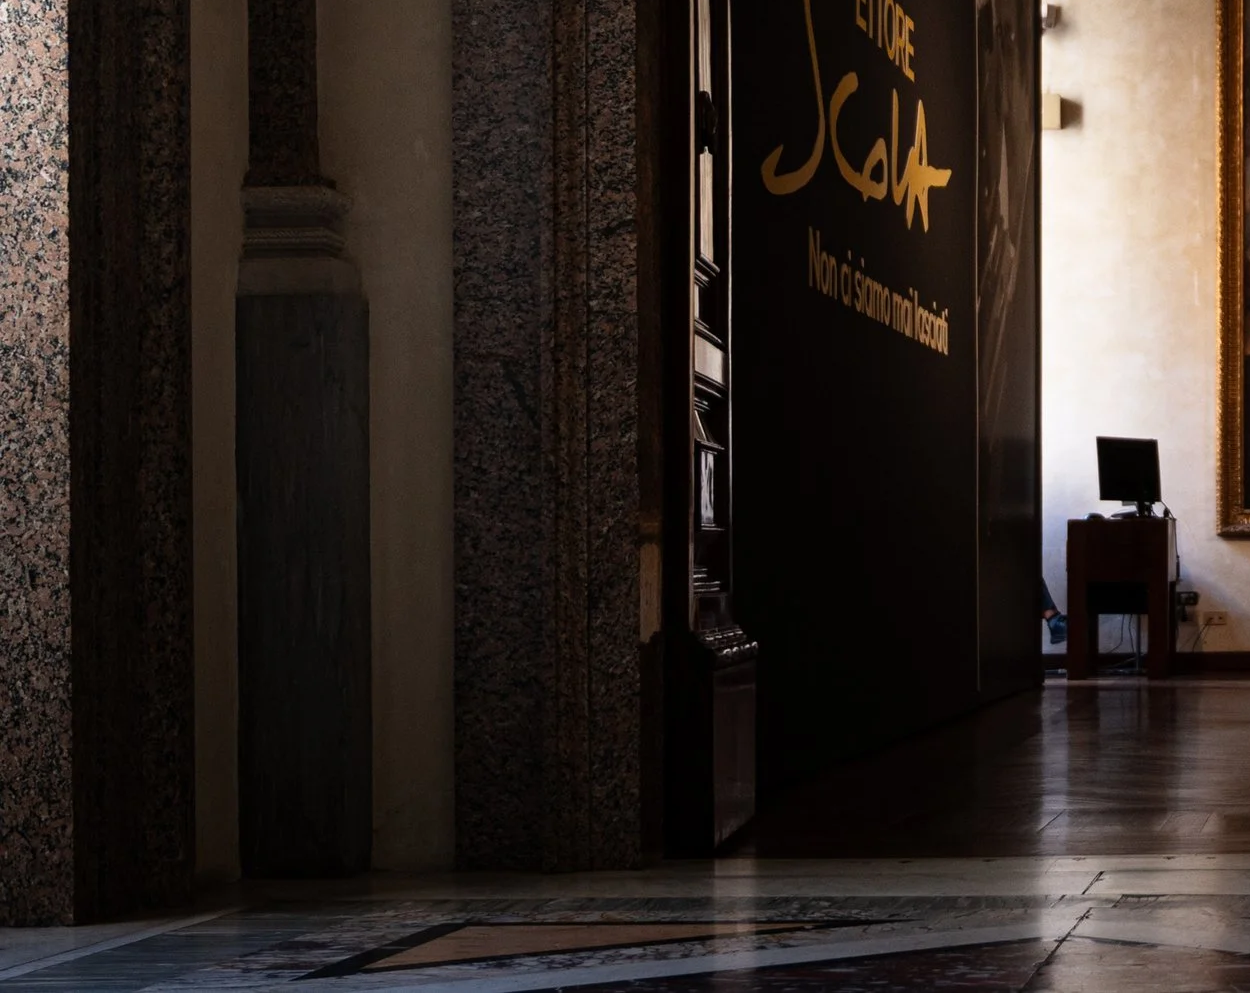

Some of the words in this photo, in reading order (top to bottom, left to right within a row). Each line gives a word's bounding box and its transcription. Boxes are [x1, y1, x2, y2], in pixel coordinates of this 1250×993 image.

[808, 225, 838, 300] Non
[840, 249, 852, 307] ci
[854, 257, 891, 326] siamo
[892, 286, 913, 338] mai
[914, 290, 949, 356] lasciati
